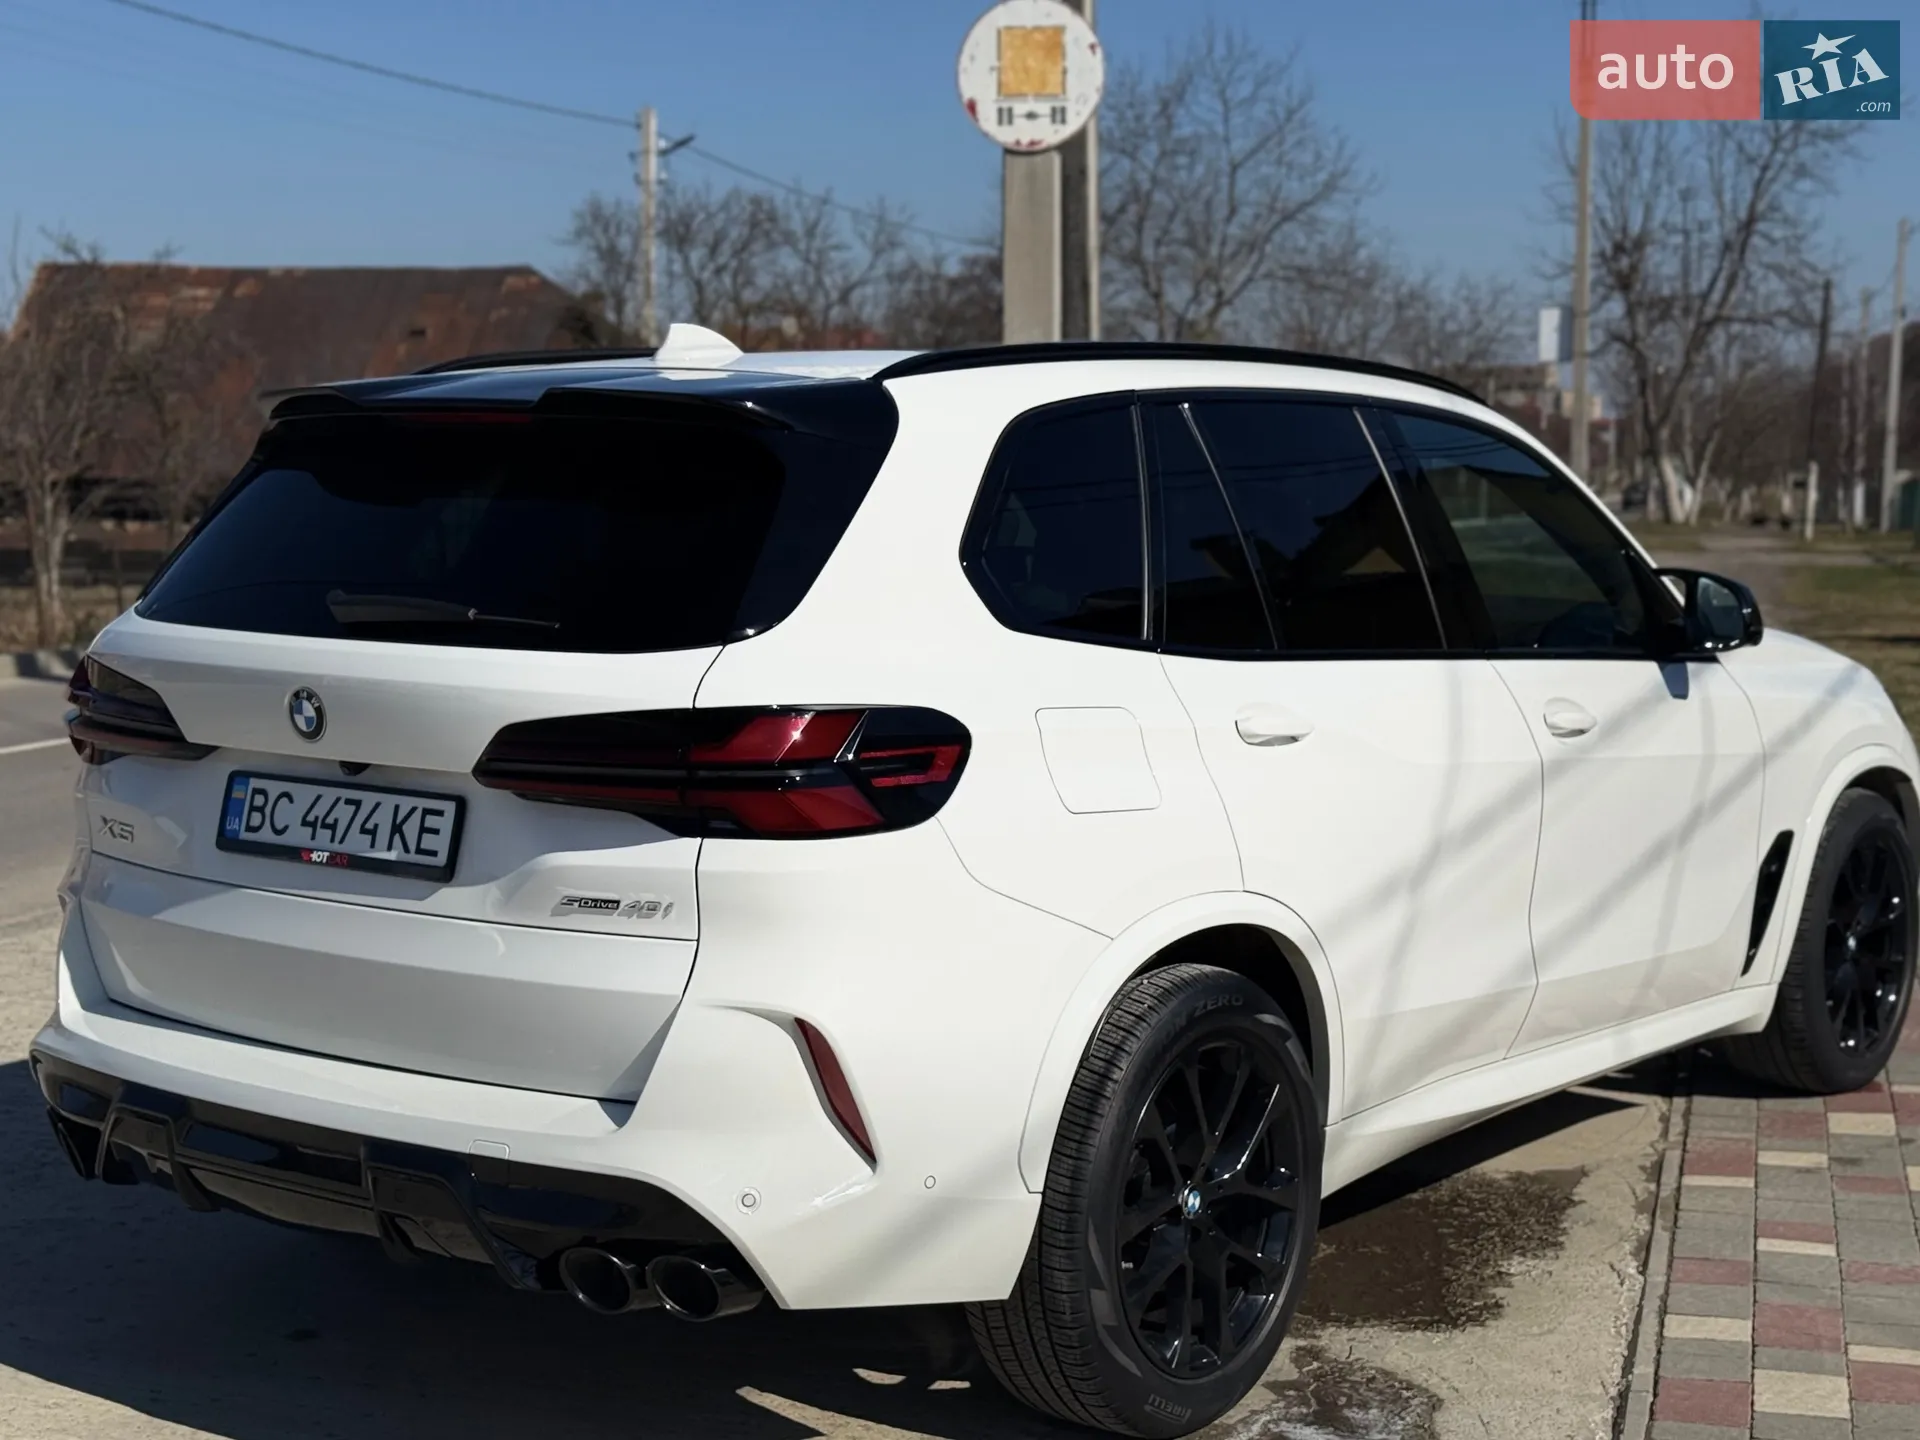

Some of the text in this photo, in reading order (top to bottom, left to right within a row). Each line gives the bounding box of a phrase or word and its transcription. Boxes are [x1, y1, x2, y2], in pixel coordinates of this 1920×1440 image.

[225, 816, 240, 832] UA
[244, 787, 295, 837] BC
[1194, 993, 1244, 1018] ZERO
